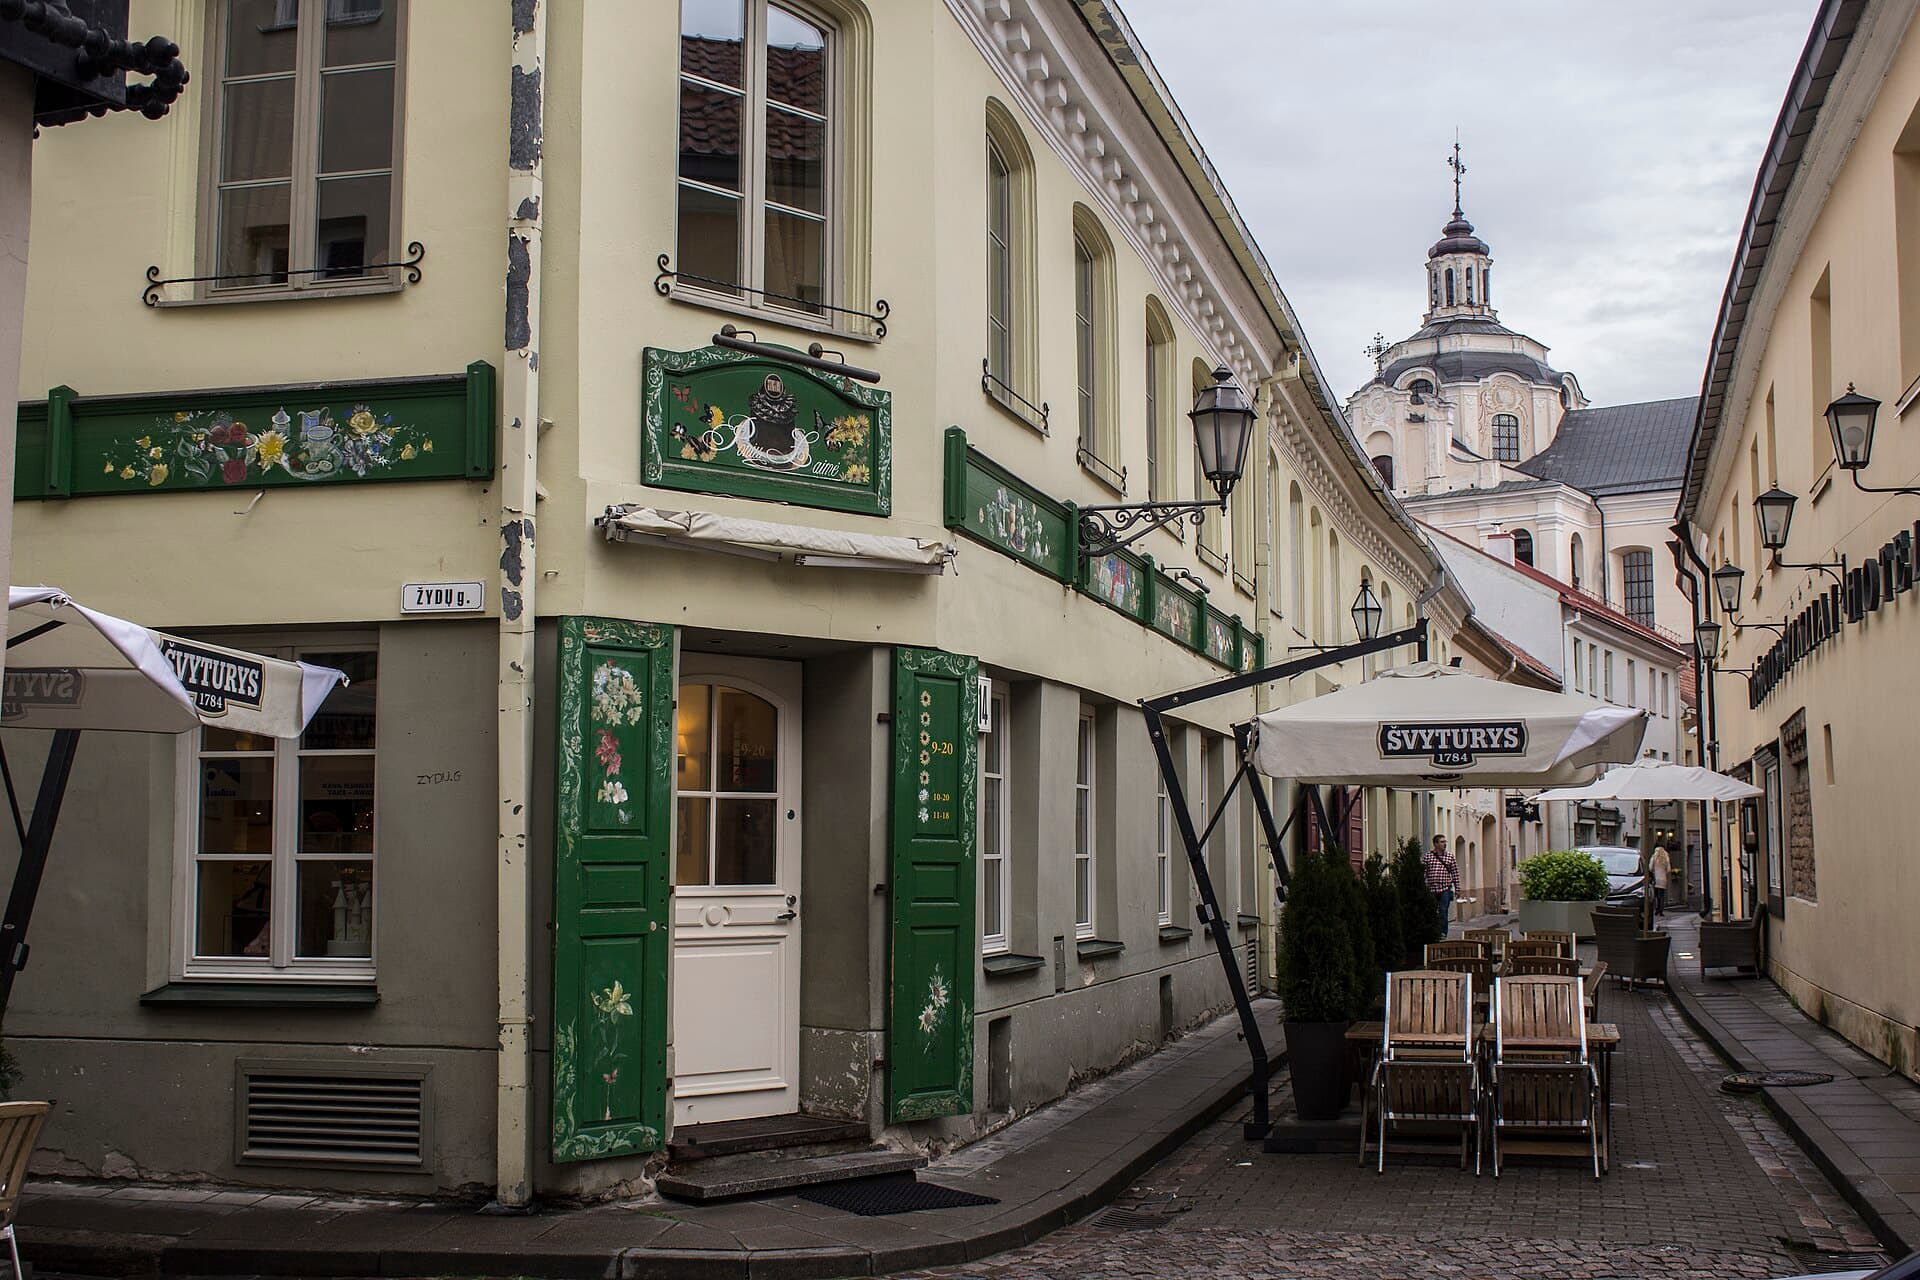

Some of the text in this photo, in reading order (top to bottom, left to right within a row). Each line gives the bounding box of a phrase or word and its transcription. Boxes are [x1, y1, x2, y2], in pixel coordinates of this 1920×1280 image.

[416, 586, 470, 607] ŽYDŲ g.
[199, 692, 223, 709] 1784
[979, 684, 988, 725] 14
[1387, 725, 1519, 751] ŠVYTURYS
[931, 741, 954, 755] 9-20
[1438, 753, 1469, 763] 1784
[933, 793, 950, 801] 10-20
[933, 811, 950, 820] 11-18
